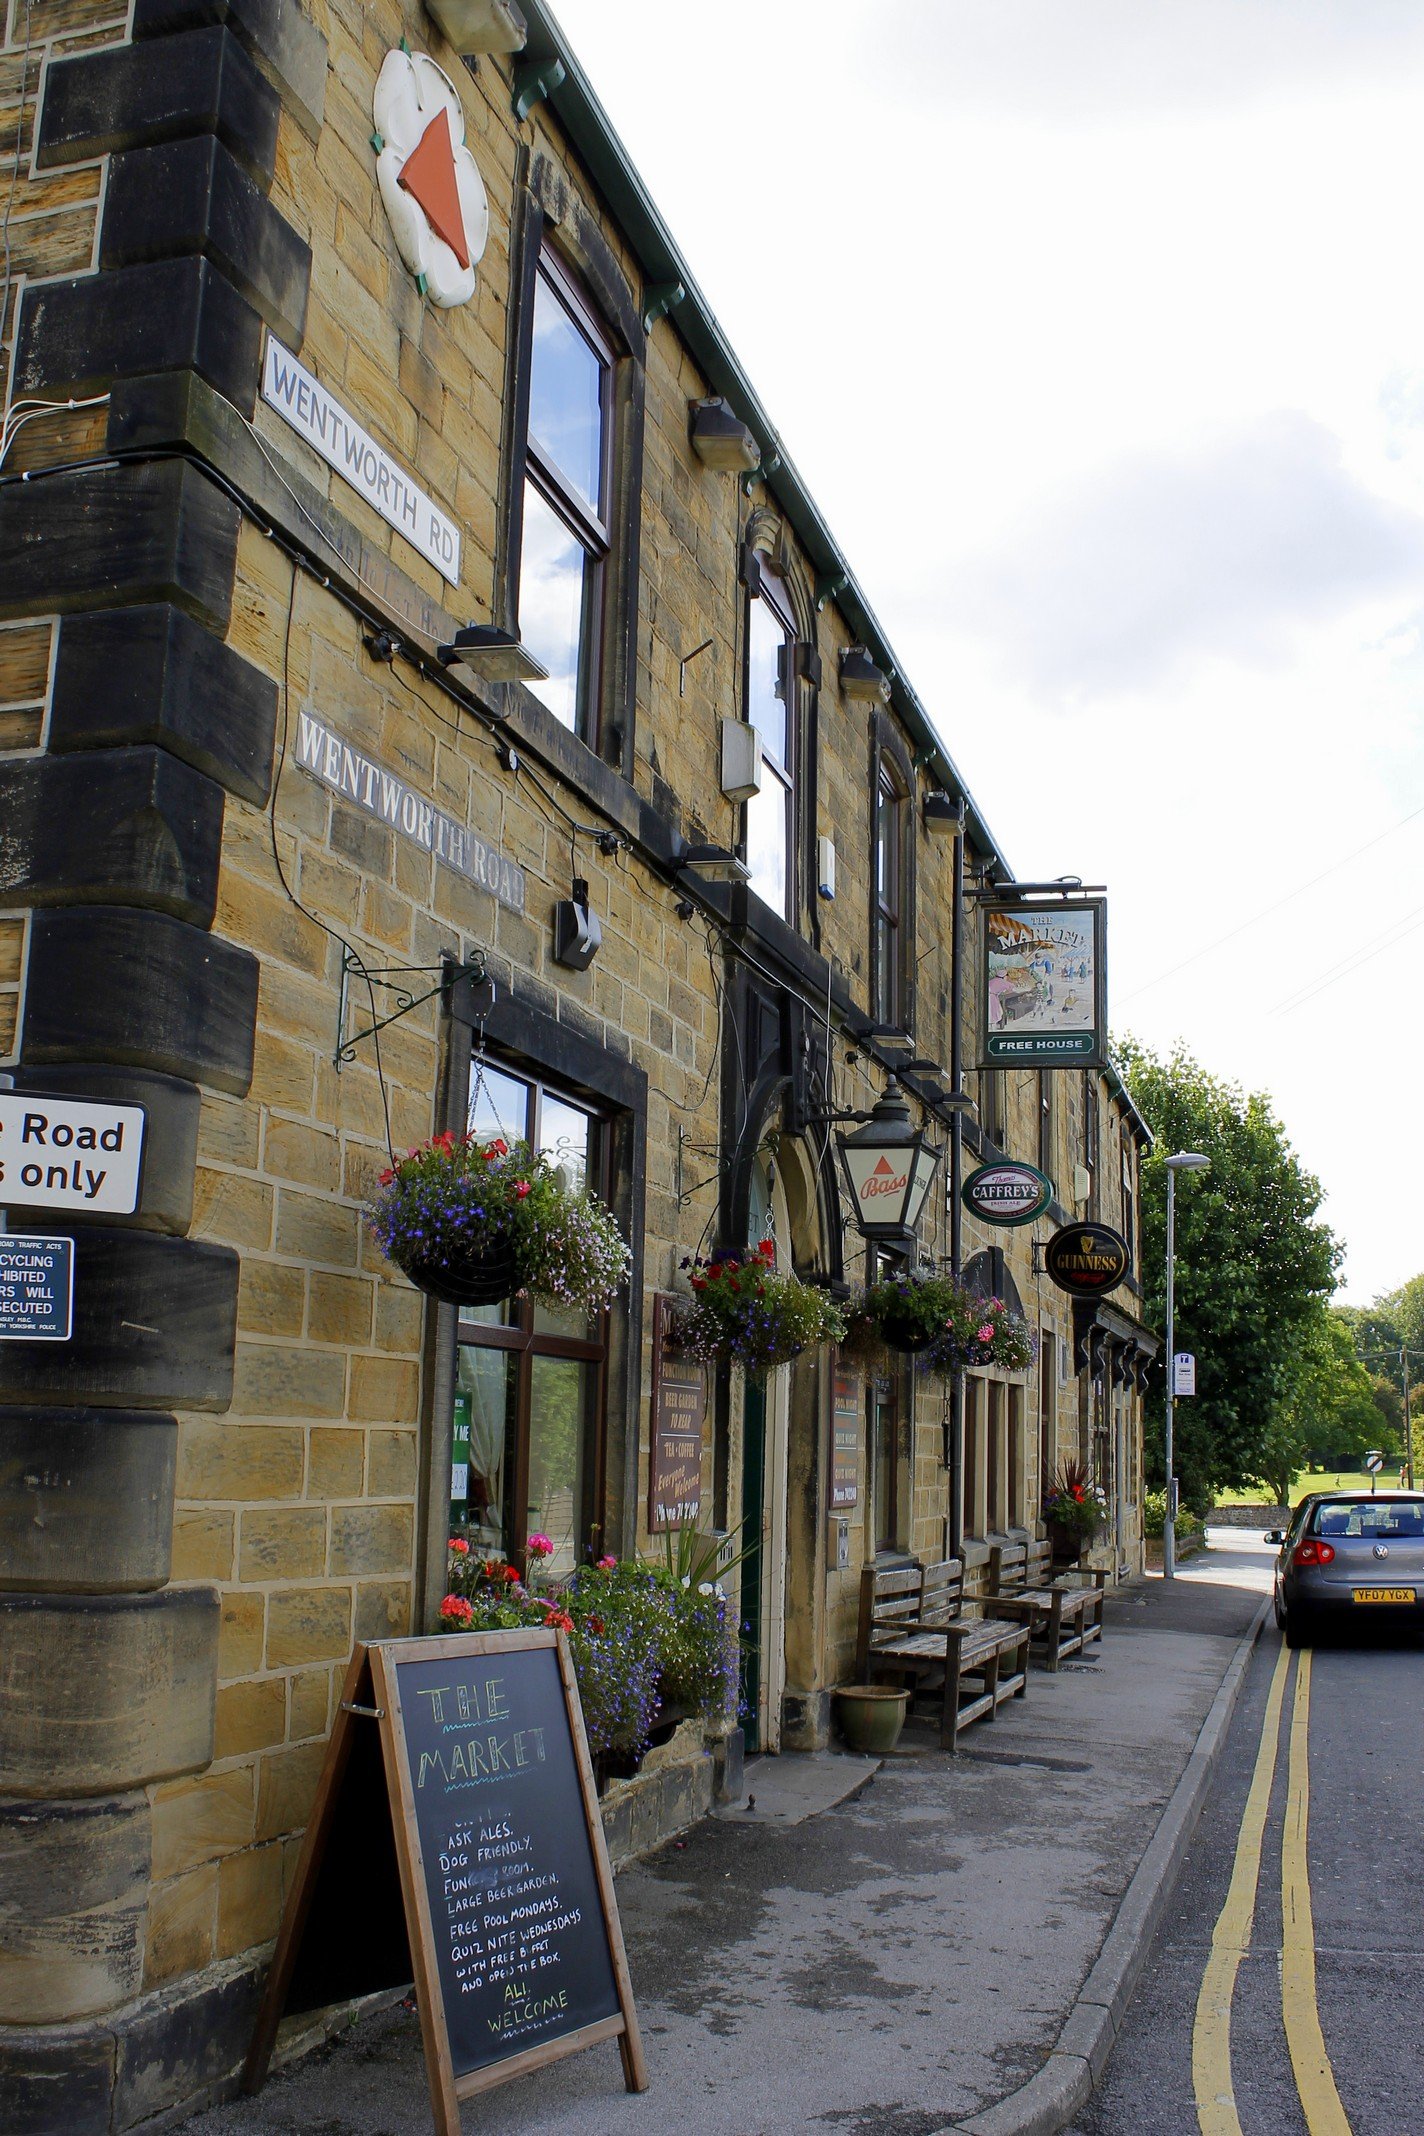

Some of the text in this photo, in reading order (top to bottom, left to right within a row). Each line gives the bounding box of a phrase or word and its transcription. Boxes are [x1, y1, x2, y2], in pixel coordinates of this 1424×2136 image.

[273, 351, 418, 531] WENTWORTH
[429, 514, 454, 565] RD
[299, 711, 465, 869] WENTWORTH
[472, 839, 524, 909] ROAD
[1030, 916, 1053, 926] THE
[997, 927, 1085, 950] MARKET
[999, 1040, 1083, 1050] FREE HOUSE
[22, 1112, 124, 1153] Road
[20, 1160, 107, 1199] only
[860, 1174, 908, 1200] Bass
[972, 1185, 1039, 1198] CAFFREY'S
[18, 1241, 43, 1250] TRAFFIC
[0, 1254, 53, 1268] CYCLING
[1056, 1254, 1117, 1271] GUINNESS
[25, 1286, 55, 1299] WILL
[0, 1301, 53, 1314] ECUTED
[665, 1391, 698, 1410] BEER GARDEN
[670, 1413, 691, 1429] TO REAR
[664, 1441, 694, 1458] TEA COFFEE
[658, 1464, 686, 1492] Everyone
[674, 1472, 700, 1498] Welcome
[1358, 1590, 1409, 1600] YF07 YGX
[416, 1679, 510, 1723] THE
[417, 1727, 546, 1788] MARKET
[480, 1822, 514, 1842] ALES.
[439, 1835, 533, 1872] DOG FRIENDLY.
[448, 1873, 559, 1914] LARGE BEER GARDEN.
[450, 1895, 563, 1939] FREE POOL MONDAYS.
[451, 1908, 582, 1962] QUIZ NITE WEDNESDAYS
[456, 1939, 549, 1978] WITH FREE BFFET
[461, 1977, 482, 1993] AND
[539, 1951, 561, 1967] BOX.
[487, 1990, 569, 2032] WELCOME
